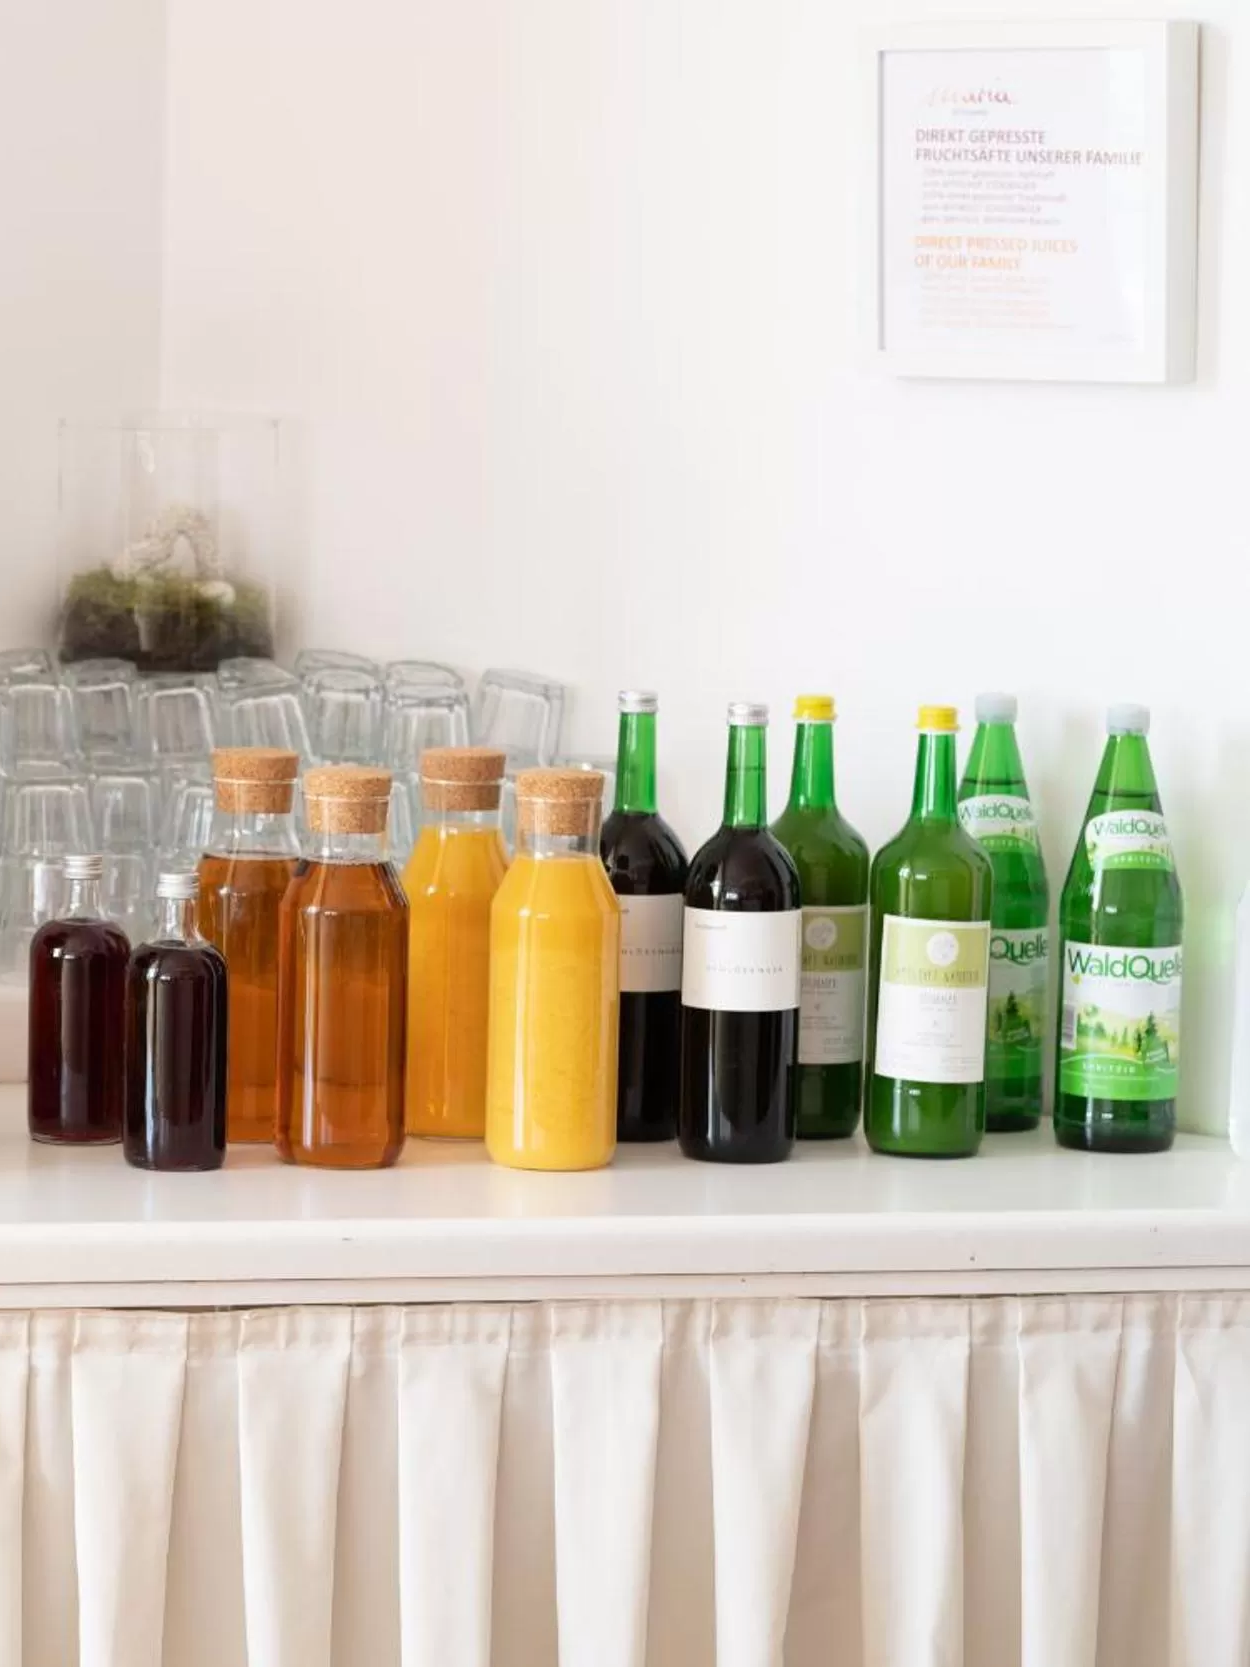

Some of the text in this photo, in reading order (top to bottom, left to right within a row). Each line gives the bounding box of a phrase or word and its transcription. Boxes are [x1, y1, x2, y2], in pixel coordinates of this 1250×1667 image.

[915, 129, 1046, 145] DIREKT GEPRESSTE
[915, 146, 1143, 166] FRUCHTSÄFTE UNSERER FAMILIE
[914, 236, 1078, 254] DIRECT PRESSED JUICES
[914, 254, 933, 268] OF
